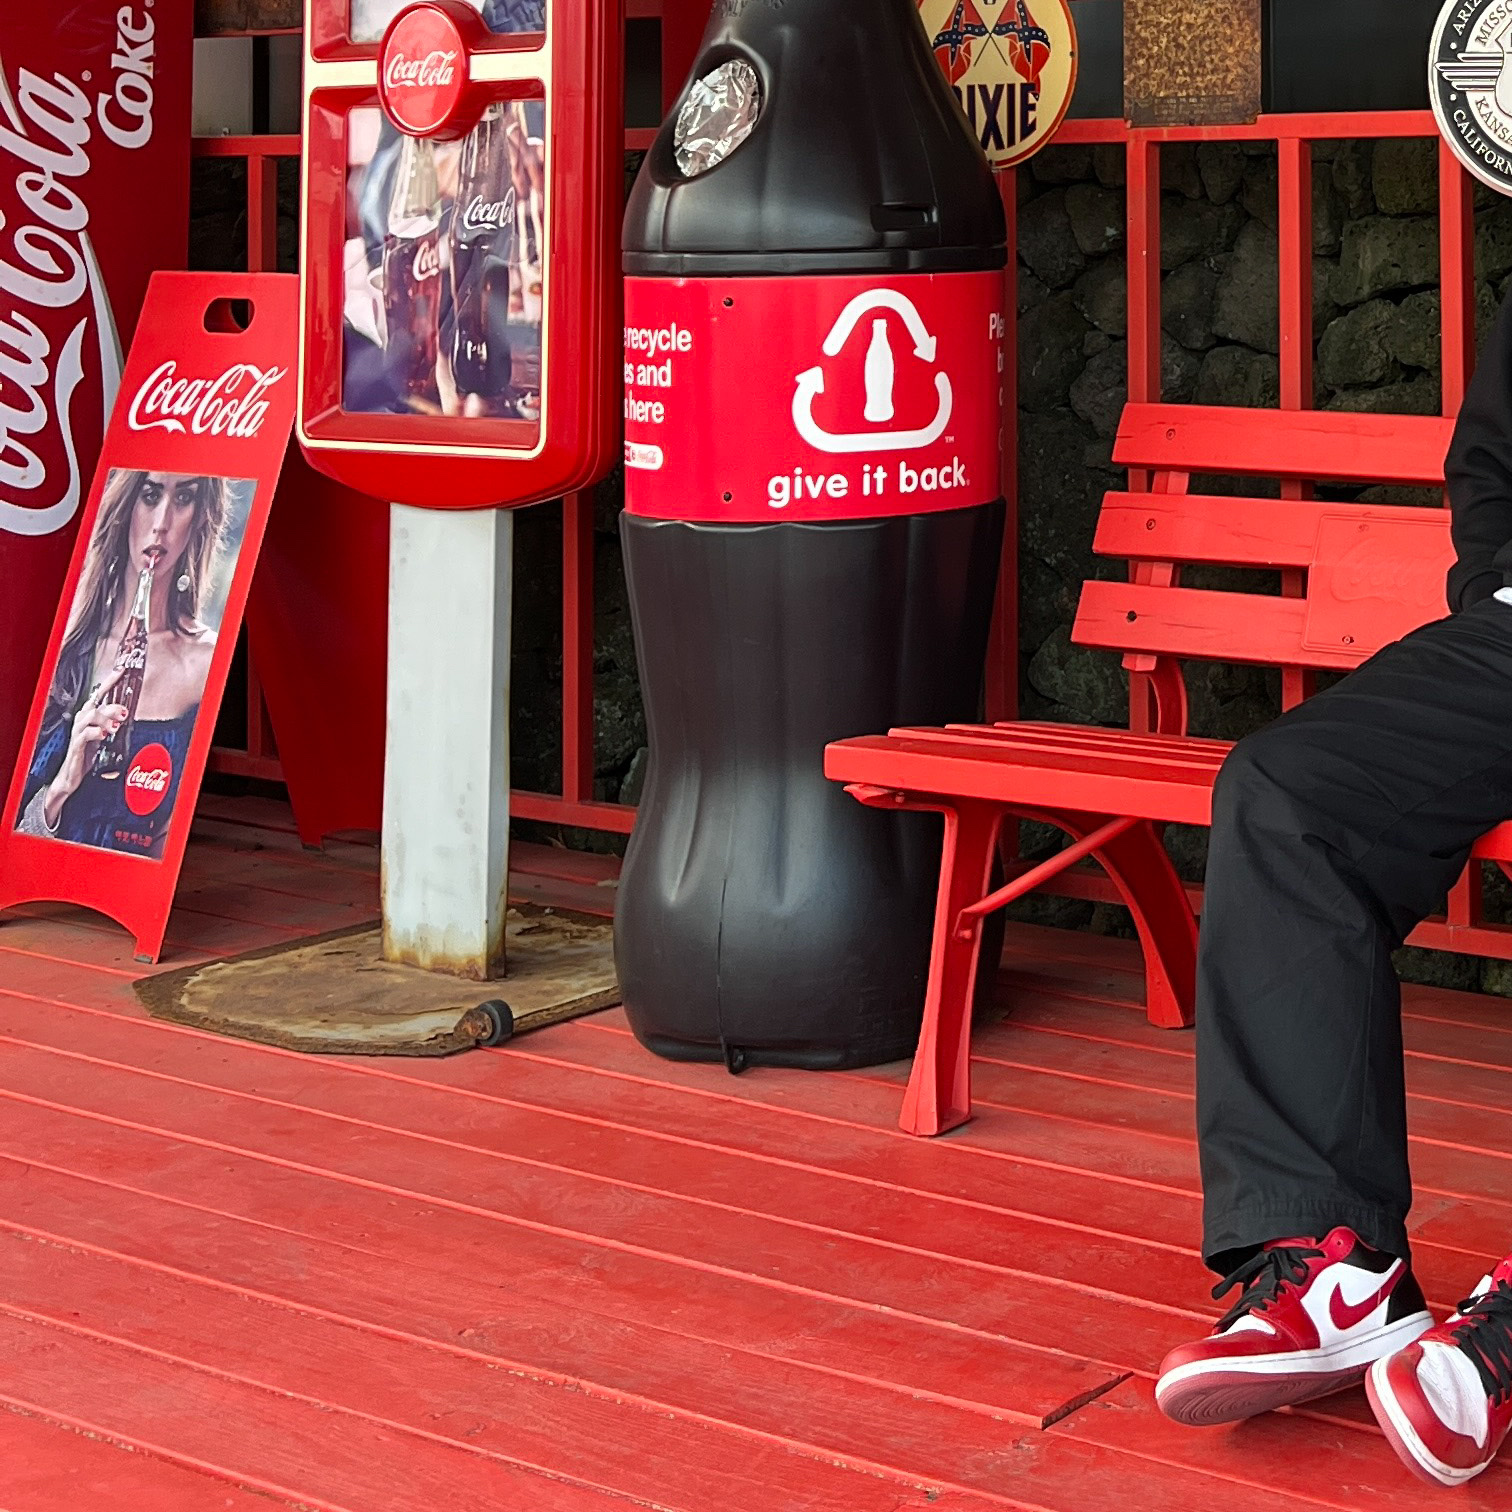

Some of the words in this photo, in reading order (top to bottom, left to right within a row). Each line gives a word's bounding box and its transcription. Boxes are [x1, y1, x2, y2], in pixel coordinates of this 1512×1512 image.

[97, 5, 155, 149] Coke
[386, 50, 459, 88] Coca-Cola
[627, 321, 693, 358] recycle
[636, 358, 672, 388] and
[127, 360, 289, 438] Coca-Cola
[628, 389, 665, 425] here
[767, 467, 849, 509] give
[862, 463, 888, 497] it
[899, 455, 967, 494] back
[127, 764, 169, 792] Coca-Cola
